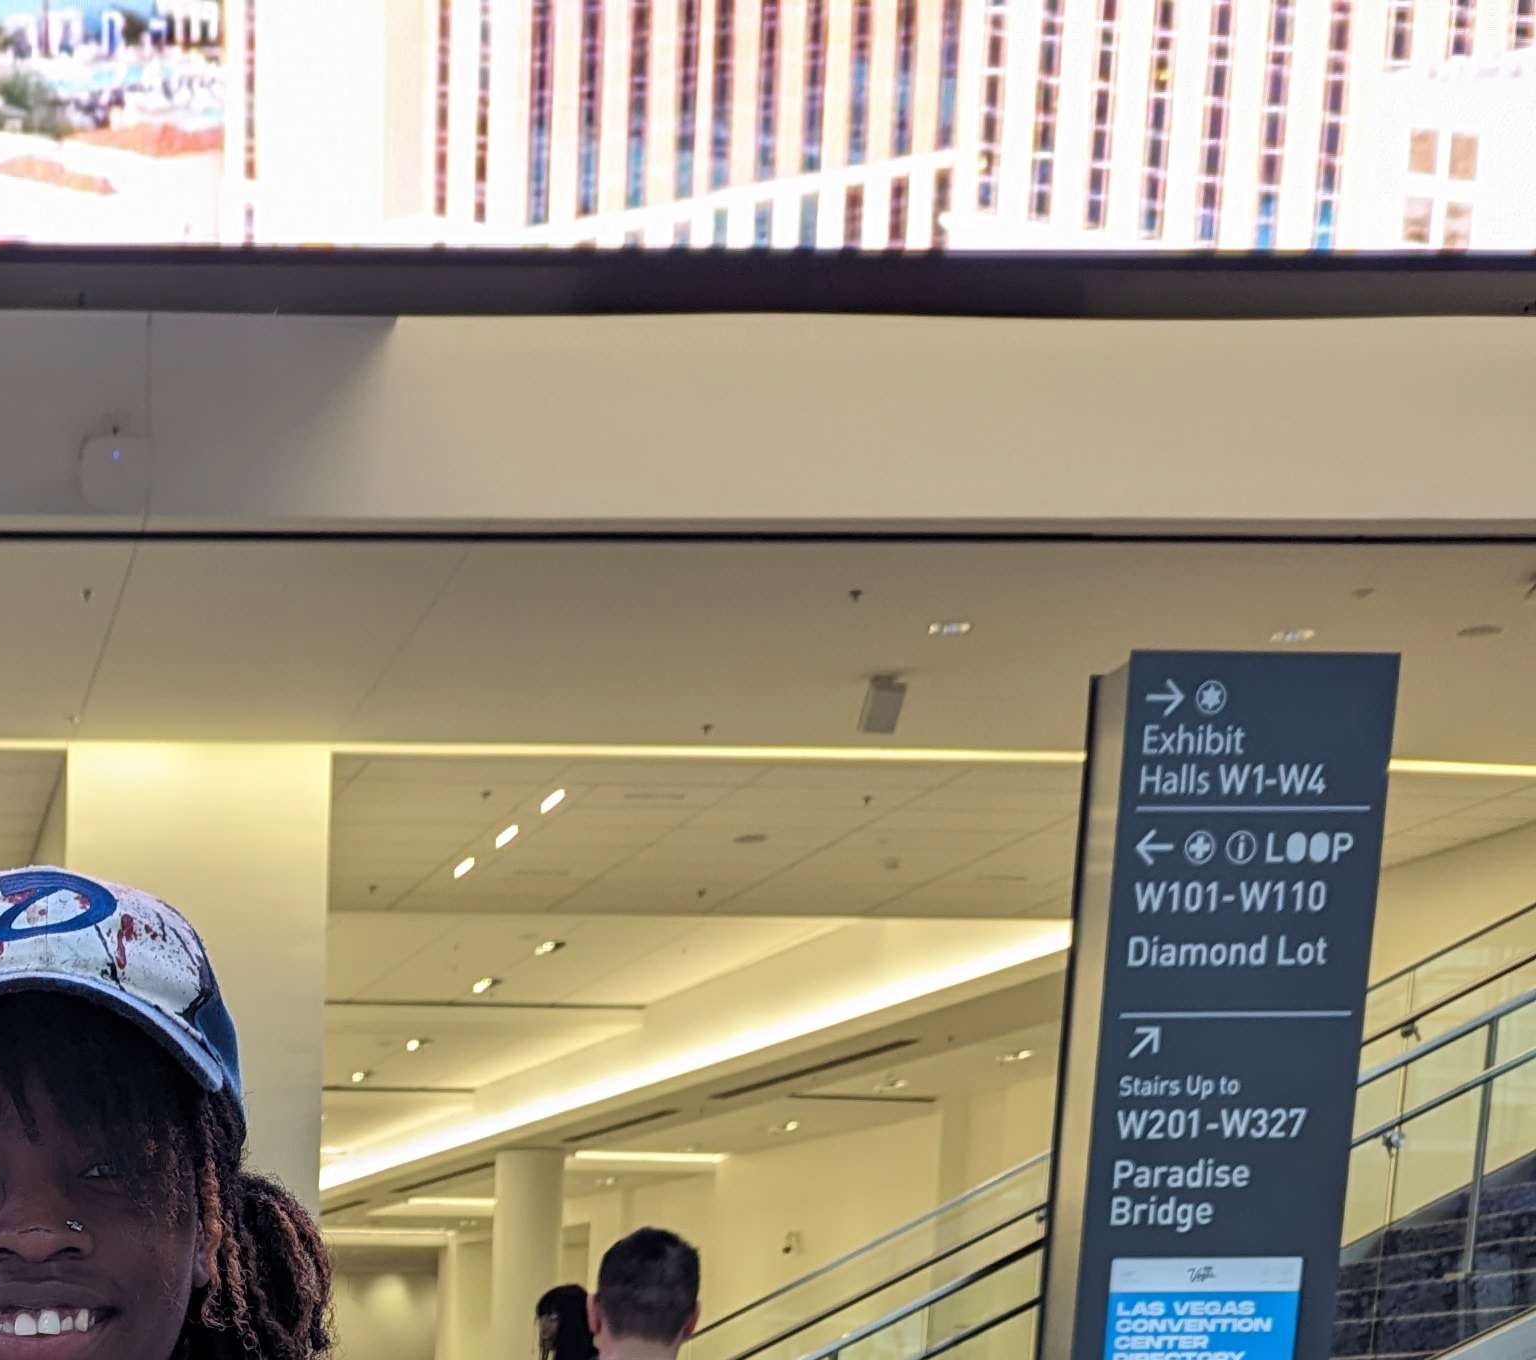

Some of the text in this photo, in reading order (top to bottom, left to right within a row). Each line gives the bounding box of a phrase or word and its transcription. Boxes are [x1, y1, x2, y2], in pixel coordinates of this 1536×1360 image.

[1142, 723, 1246, 756] Exhibit
[1139, 762, 1327, 796] Halls W1-W4
[1134, 880, 1327, 913] W101-W110
[1126, 934, 1328, 968] Diamond Lot
[1119, 1074, 1241, 1101] Stairs Up to
[1112, 1157, 1251, 1190] Paradise
[1109, 1195, 1214, 1233] Bridge
[1115, 1318, 1272, 1333] CONVENTION
[1116, 1301, 1255, 1317] LAS VEGAS
[1114, 1335, 1208, 1350] CENTER
